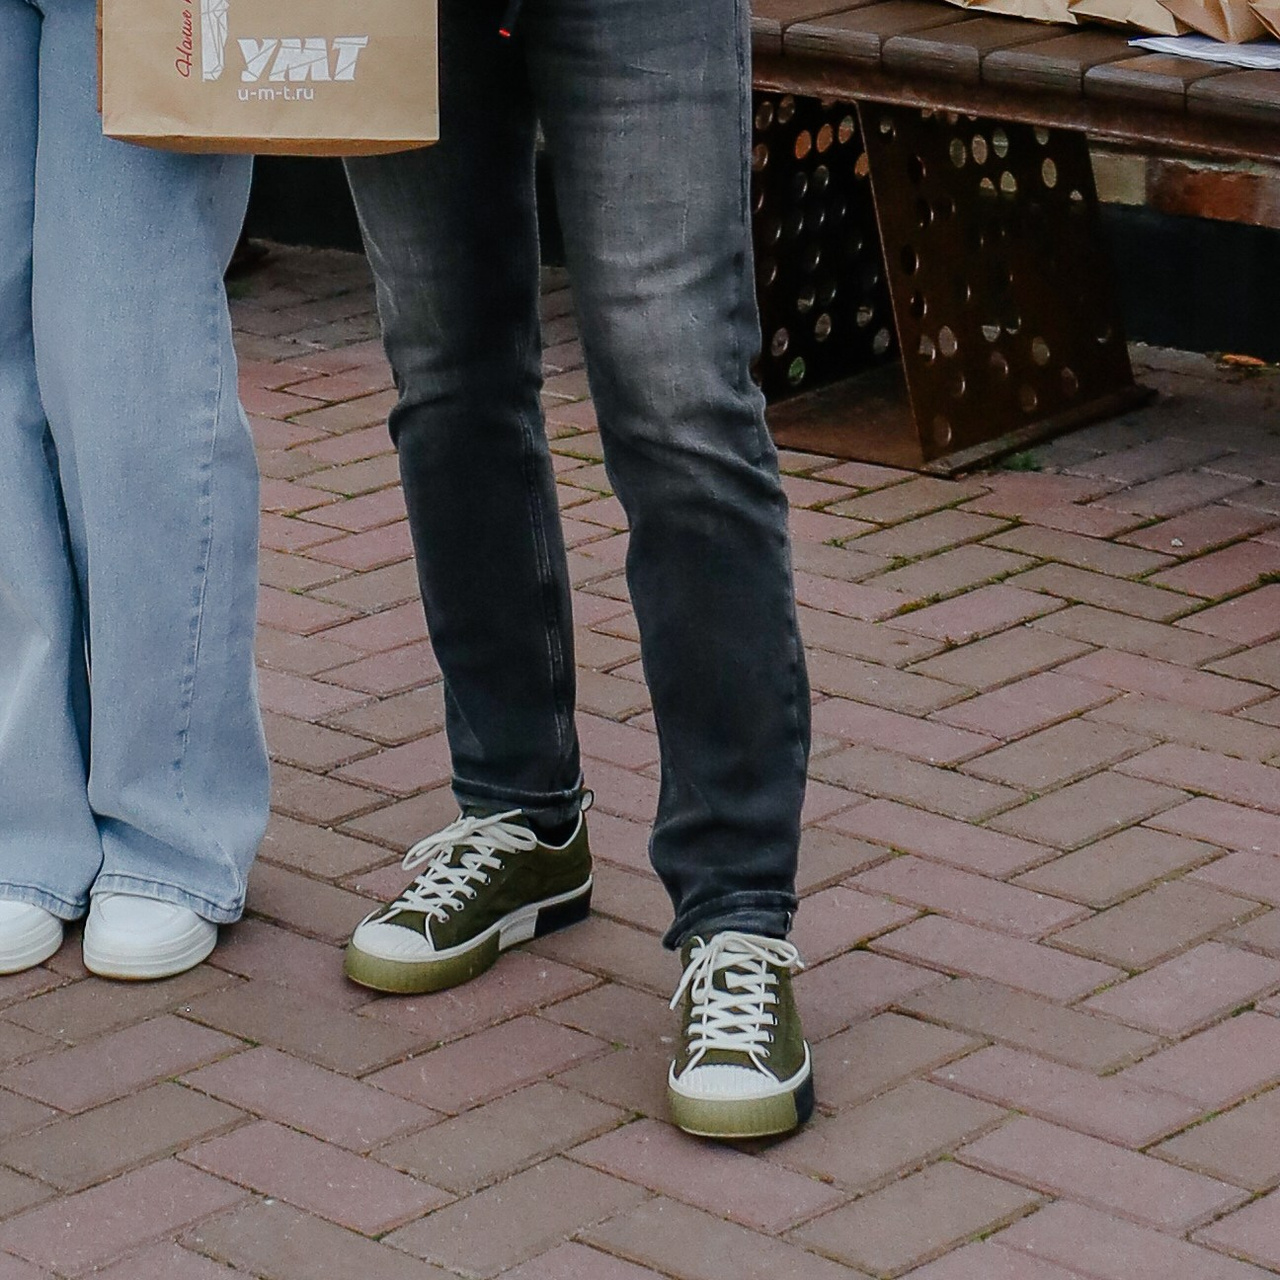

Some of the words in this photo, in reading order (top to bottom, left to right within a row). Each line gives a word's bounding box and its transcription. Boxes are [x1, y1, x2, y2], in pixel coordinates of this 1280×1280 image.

[175, 9, 193, 78] Наше
[236, 35, 369, 82] УМТ
[237, 85, 314, 101] u-m-t.ru
